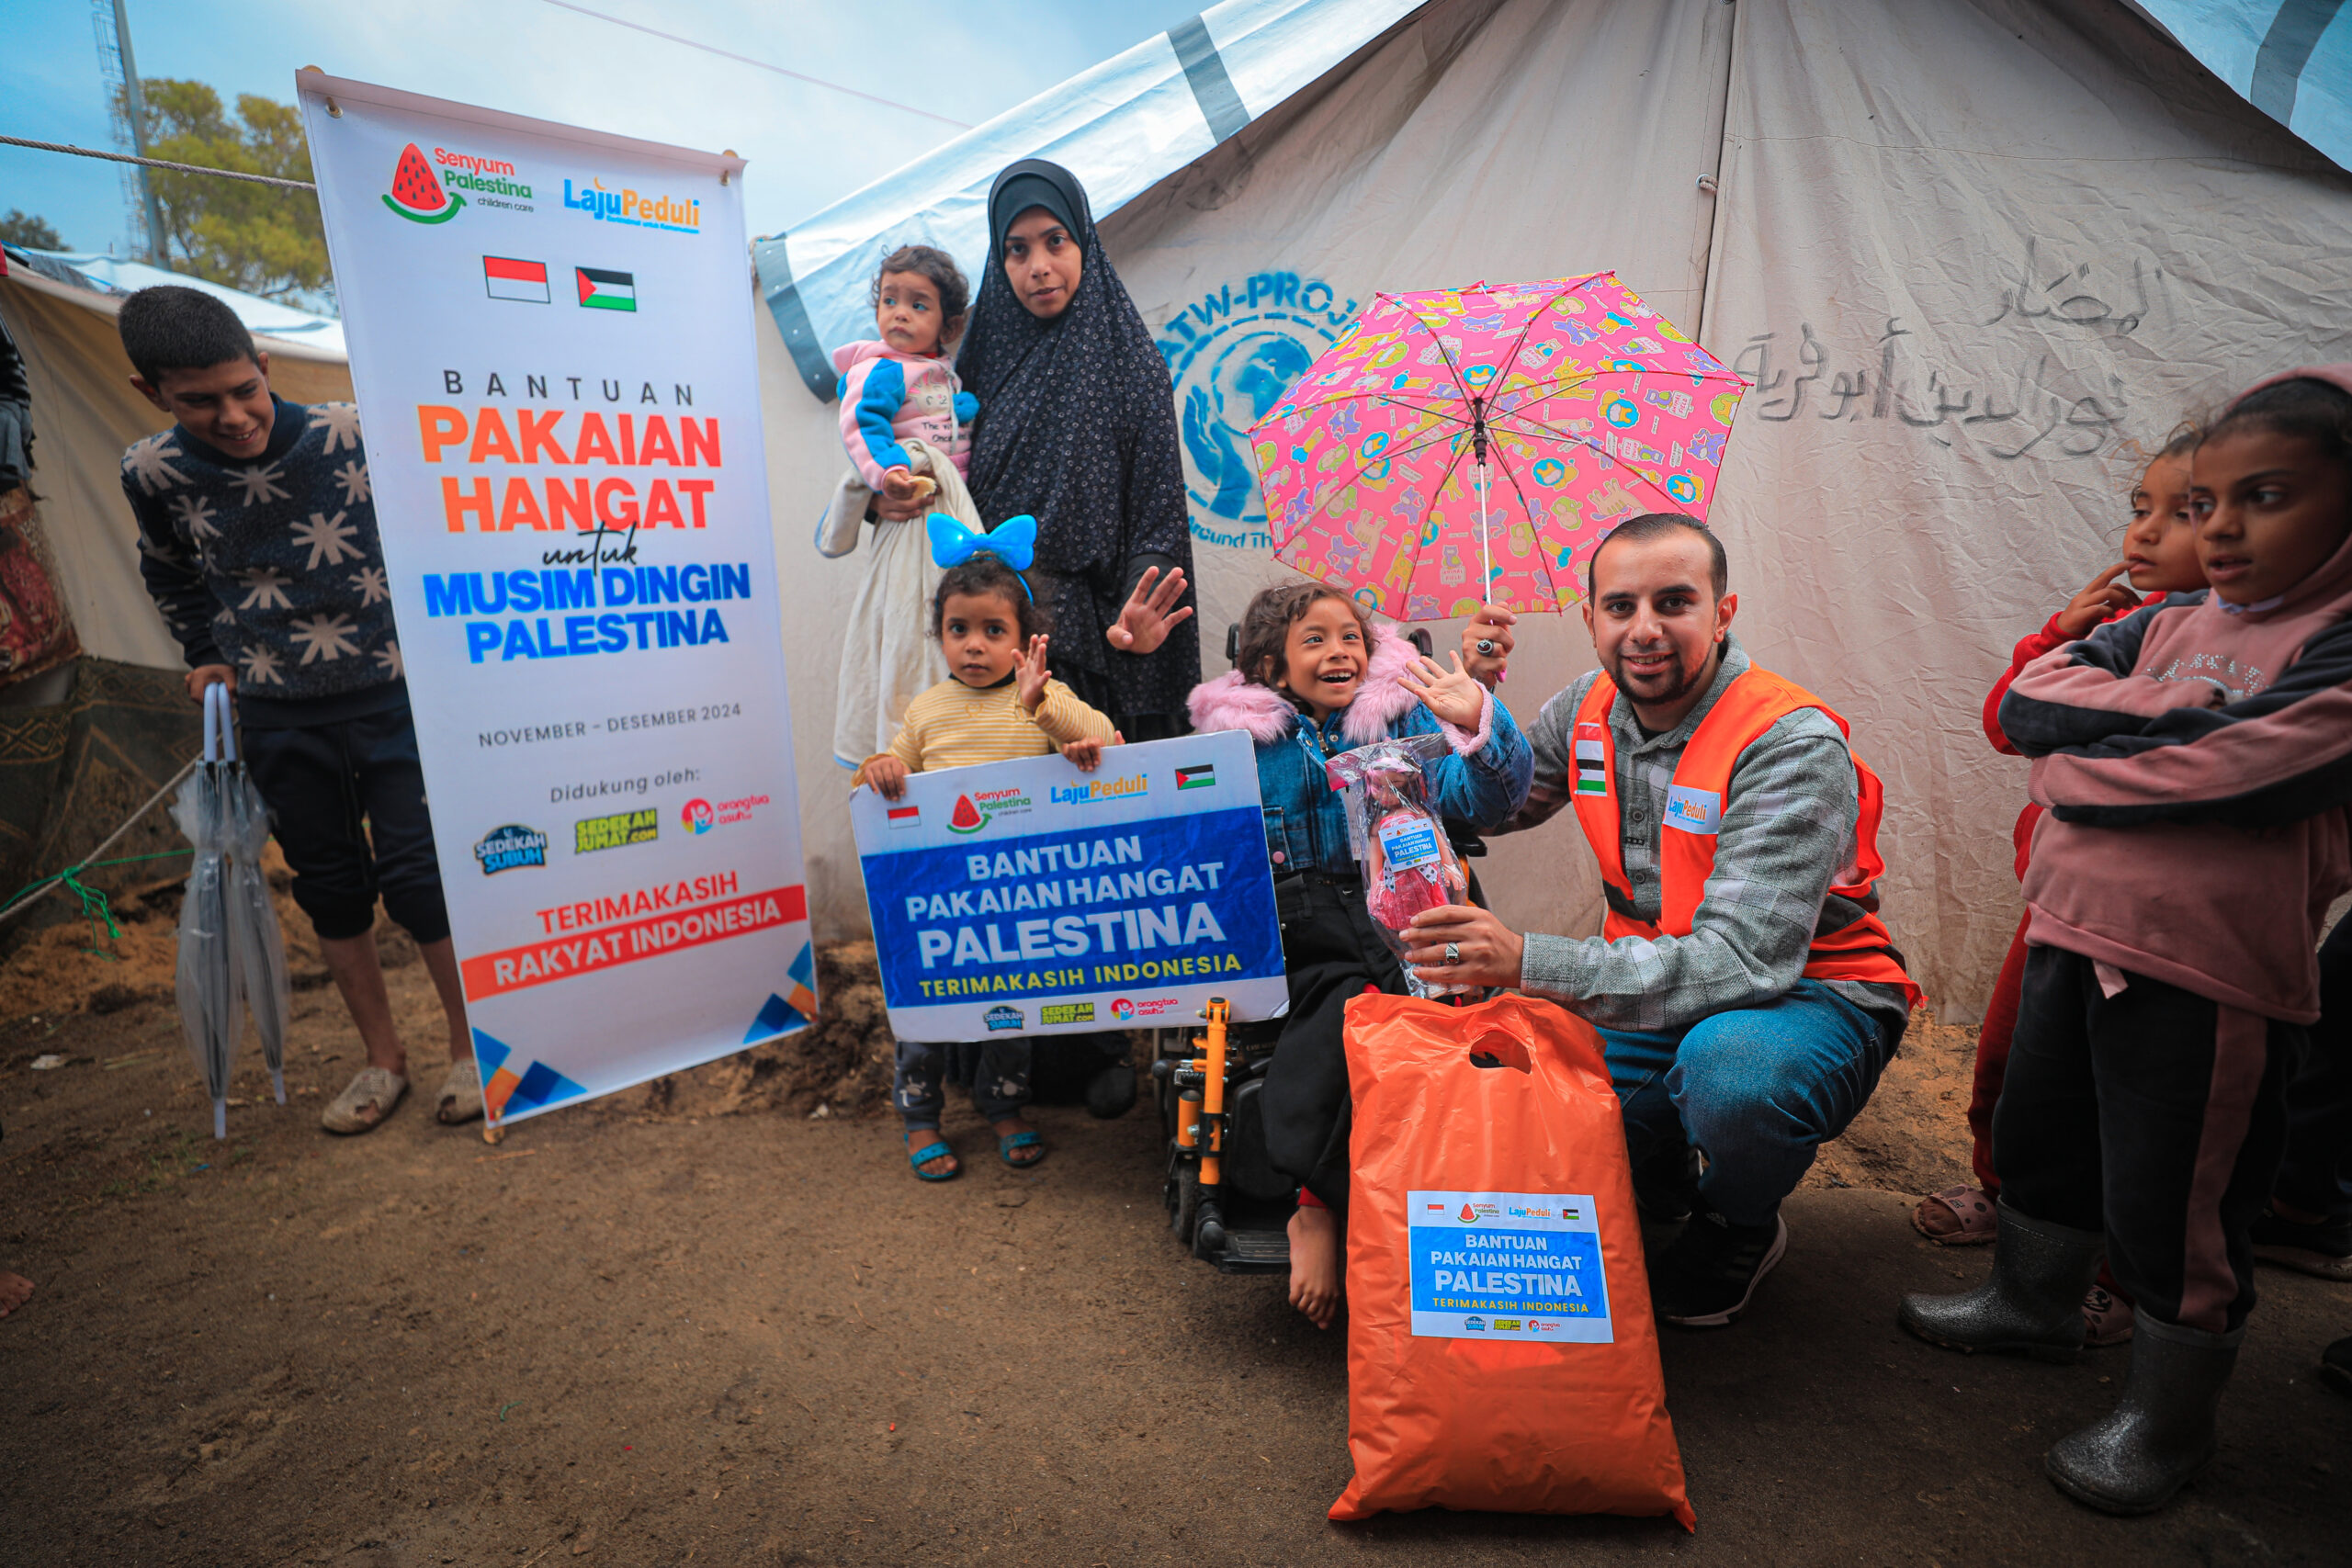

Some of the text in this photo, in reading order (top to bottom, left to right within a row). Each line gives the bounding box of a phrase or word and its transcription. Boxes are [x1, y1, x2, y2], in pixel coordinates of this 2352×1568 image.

[434, 147, 514, 176] Senyum
[444, 169, 533, 198] Palestina
[477, 197, 534, 213] children care
[564, 176, 700, 227] LajuPeduli
[444, 370, 693, 405] BANTUAN
[417, 404, 722, 468] PAKAIAN
[441, 477, 714, 532] HANGAT
[542, 520, 638, 576] untuk
[1250, 532, 1273, 548] Th
[423, 563, 752, 617] MUSIM DINGIN
[466, 608, 729, 663] PALESTINA
[479, 722, 586, 748] NOVEMBER
[607, 705, 696, 733] DESEMBER
[702, 703, 741, 721] 2024
[550, 769, 701, 803] Didukung oleh:
[974, 787, 1021, 803] Senyum
[1051, 773, 1148, 806] LajuPeduli
[718, 794, 770, 812] orangtua
[979, 796, 1032, 812] Palestina
[1668, 794, 1707, 820] LajuPeduli
[576, 808, 657, 836] SEDEKAH
[476, 833, 547, 858] SEDEKAH
[967, 836, 1143, 882] BANTUAN
[1394, 842, 1433, 858] PALESTINA
[485, 849, 544, 874] SUBUH
[536, 871, 738, 934] TERIMAKASIH
[906, 862, 1224, 922] PAKAIAN HANGAT
[493, 897, 782, 987] RAKYAT INDONESIA
[917, 902, 1227, 970] PALESTINA
[920, 953, 1242, 998] TERIMAKASIH INDONESIA
[984, 1012, 1024, 1022] SEDEKAH
[1041, 1003, 1093, 1017] SEDEKAH
[1136, 998, 1179, 1009] orangtua
[1509, 1206, 1551, 1218] LajuPeduli
[1465, 1234, 1547, 1251] BANTUAN
[1430, 1251, 1582, 1270] PAKAIAN HANGAT
[1435, 1269, 1583, 1297] PALESTINA
[1433, 1297, 1589, 1313] TERIMAKASIH INDONESIA
